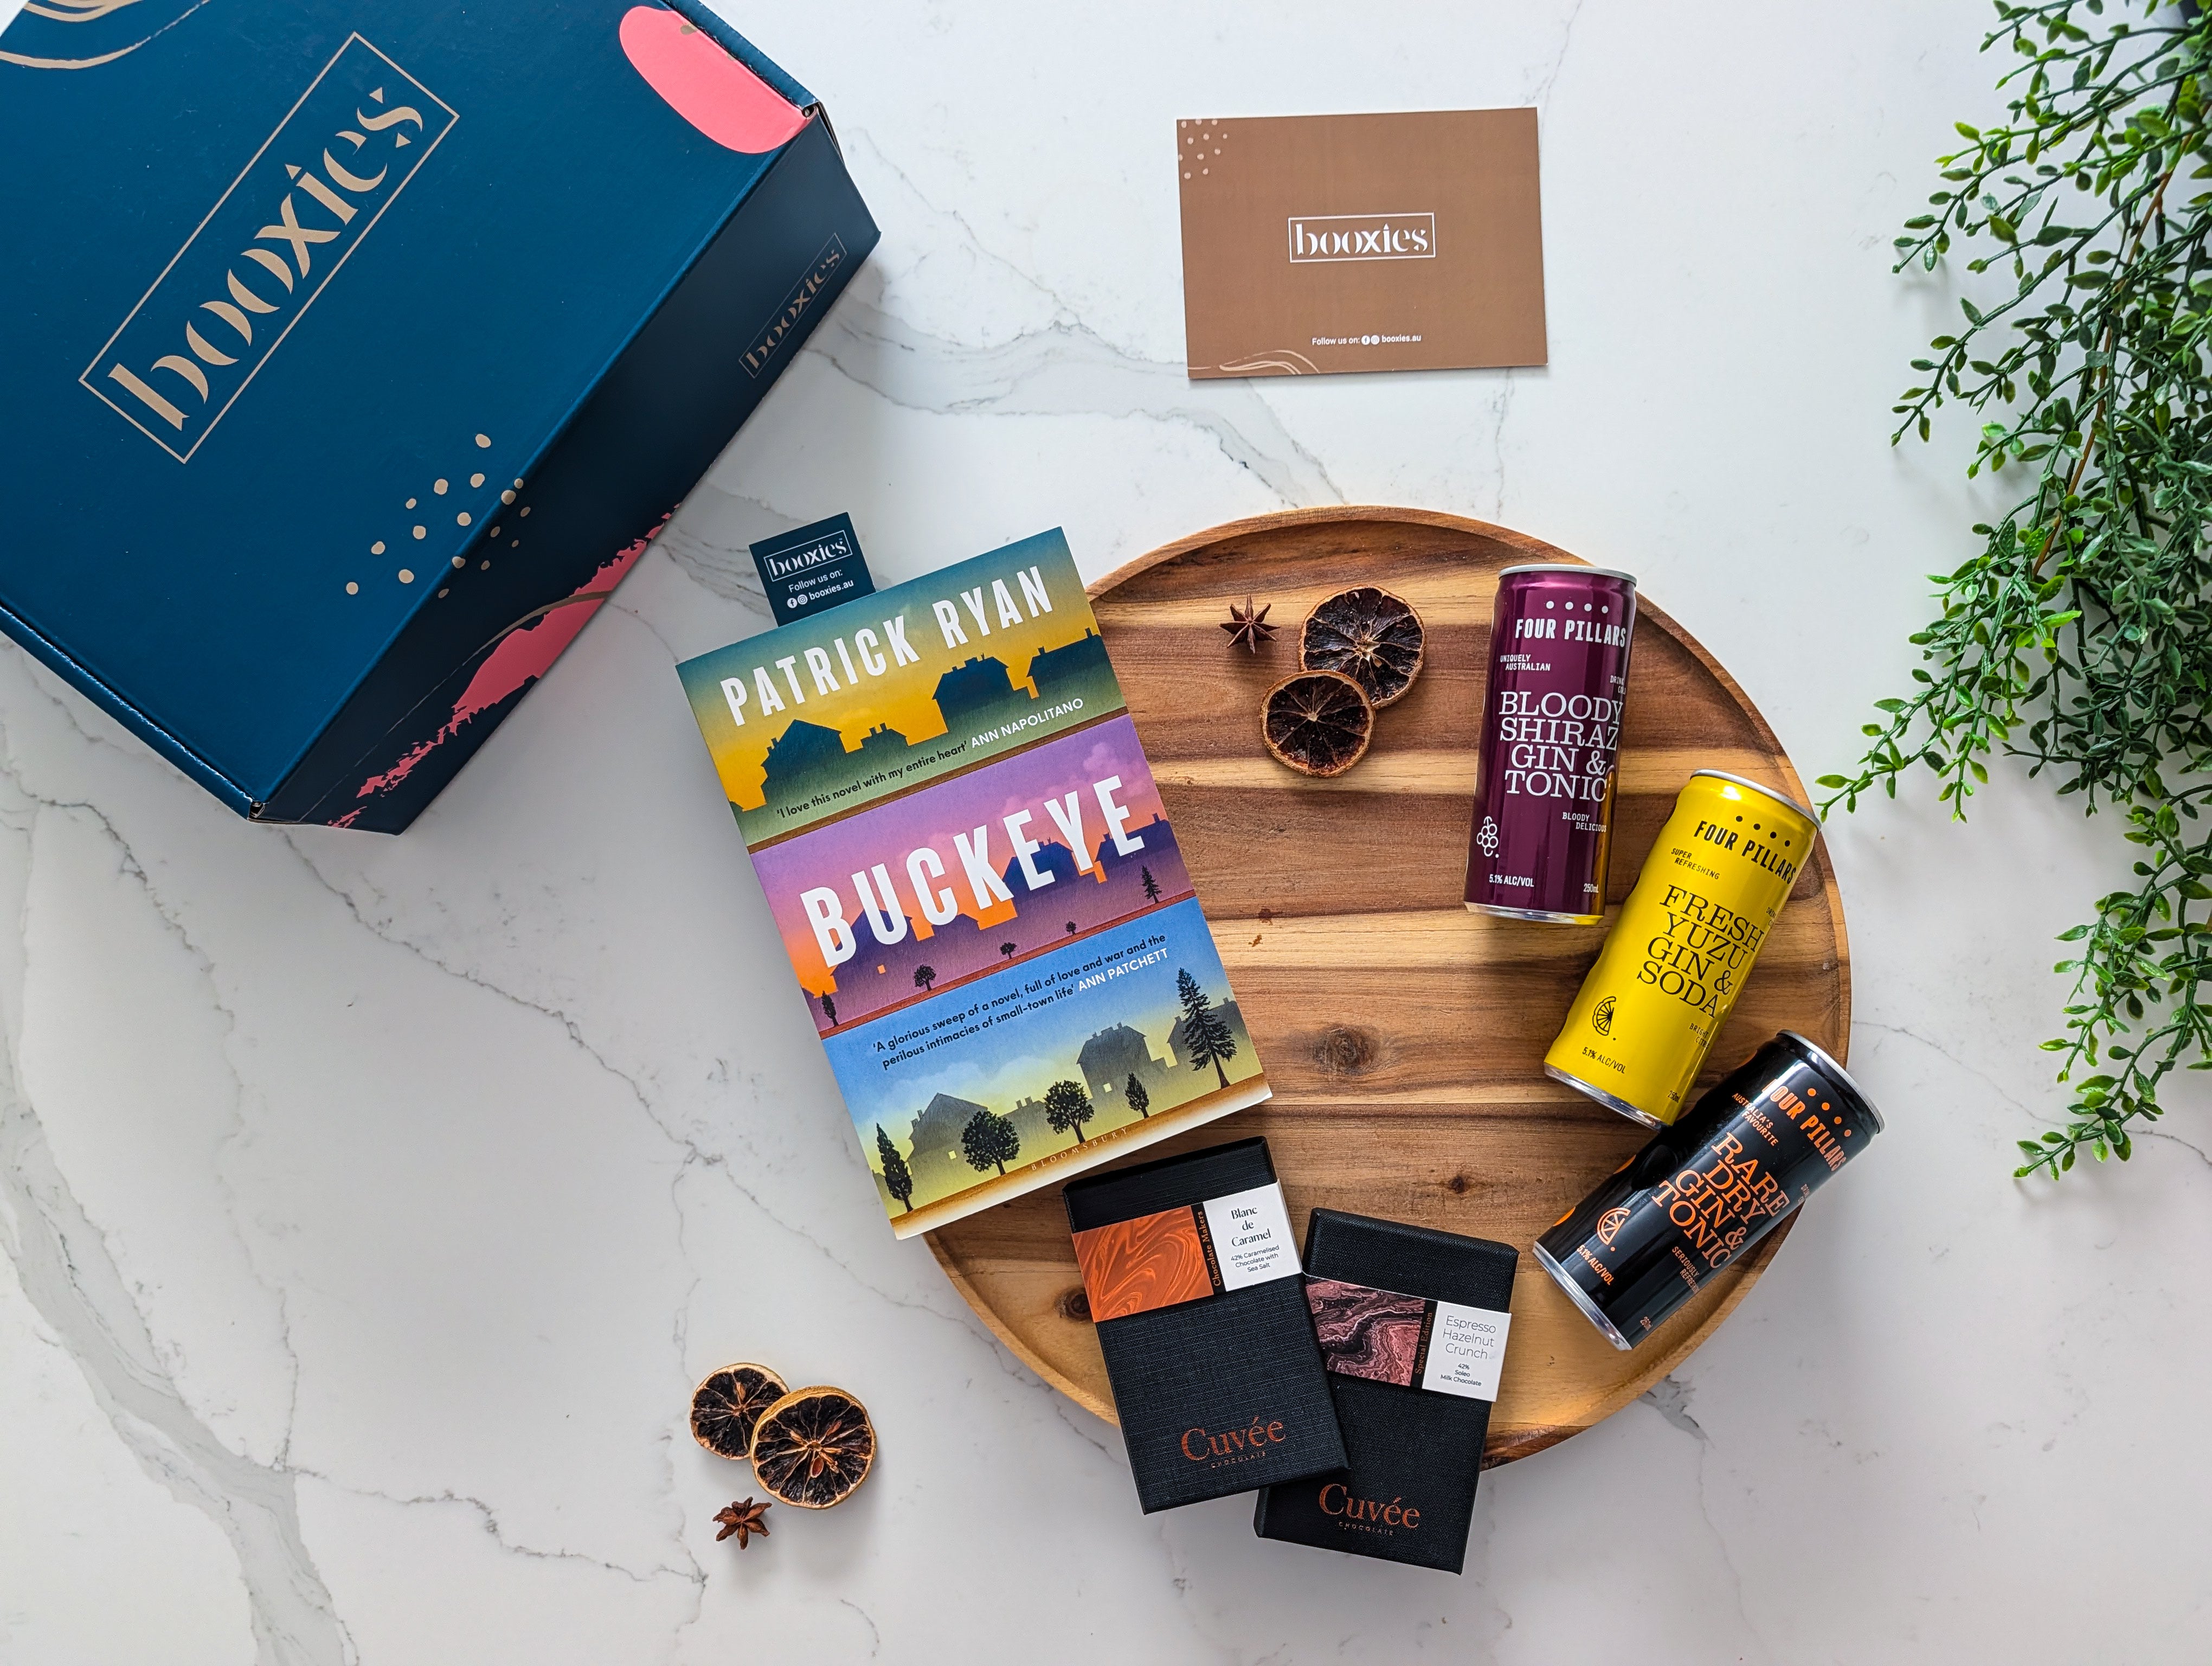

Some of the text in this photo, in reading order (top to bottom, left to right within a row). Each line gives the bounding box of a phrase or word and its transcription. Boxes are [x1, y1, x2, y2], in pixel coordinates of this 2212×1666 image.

[1296, 223, 1428, 255] booxies
[108, 87, 423, 431] booxies
[746, 248, 839, 369] booxies
[1312, 337, 1336, 345] Follow
[1381, 335, 1422, 343] booxies.au
[769, 541, 847, 576] booxies
[788, 569, 843, 593] Follow us on:
[808, 580, 854, 600] booxies.au
[721, 565, 1053, 727] PATRICK RYAN
[1515, 619, 1626, 648] FOUR PILLARS
[1500, 654, 1531, 662] UNIQUELY
[1505, 663, 1551, 671] AUSTRALIAN
[1499, 691, 1623, 725] BLOODY
[1500, 717, 1619, 751] SHIRAZ
[786, 802, 810, 816] love
[812, 793, 831, 806] this
[832, 780, 861, 799] novel
[863, 772, 886, 787] with
[888, 767, 903, 778] my
[906, 756, 936, 772] entire
[937, 740, 967, 760] heart'
[972, 729, 999, 748] ANN
[1000, 698, 1083, 736] NAPOLITANO
[1511, 744, 1606, 776] GIN &
[1504, 770, 1607, 802] TONIC
[1562, 812, 1590, 822] BLOODY
[1576, 822, 1606, 832] DELICIOUS
[1671, 848, 1692, 860] SUPER
[1674, 858, 1720, 880] REFRESHING
[1694, 821, 1797, 885] FOUR PILLARS
[800, 774, 1146, 968] BUCKEYE
[1489, 874, 1534, 887] 5.1% ALC/VOL
[1659, 884, 1765, 952] FRESH
[1663, 912, 1748, 970] YUZU
[1648, 937, 1733, 995] GIN &
[888, 1026, 930, 1050] glorious
[932, 1013, 966, 1030] sweep
[968, 1003, 979, 1016] of
[991, 988, 1024, 1008] novel,
[1025, 979, 1042, 994] full
[1044, 973, 1056, 986] of
[1057, 968, 1081, 982] love
[1082, 956, 1103, 972] and
[1104, 951, 1124, 963] war
[1127, 939, 1147, 954] and
[1148, 934, 1166, 946] the
[1637, 960, 1719, 1018] SODA
[882, 948, 1168, 1071] perilous intimacies of small-town life' ANN PATCHETT
[1689, 1023, 1709, 1038] BRIGHT
[1582, 1047, 1626, 1074] 5.1% ALC/VOL
[1732, 1093, 1773, 1129] AUSTRALIA'S
[1742, 1111, 1778, 1146] FAVOURITE
[1800, 1115, 1847, 1171] PILLARS
[1031, 1127, 1128, 1171] BLOOMSBURY
[1712, 1132, 1790, 1217] RARE
[1702, 1159, 1766, 1224] DRY
[1231, 1207, 1258, 1219] Blanc
[1242, 1220, 1255, 1231] de
[1651, 1181, 1732, 1268] TONIC
[1676, 1169, 1747, 1249] GIN &
[1198, 1211, 1221, 1286] Chocolate Makers
[1232, 1228, 1271, 1247] Caramel
[1244, 1245, 1279, 1259] Caramelised
[1235, 1257, 1264, 1267] Chocolate
[1577, 1245, 1614, 1285] 5.1% ALC/VOL
[1672, 1246, 1700, 1277] SERIOUSLY
[1443, 1328, 1495, 1347] Hazelnut
[1446, 1315, 1496, 1334] Espresso
[1415, 1312, 1433, 1374] Special Edition
[1445, 1343, 1488, 1360] Crunch
[1453, 1376, 1482, 1386] Chocolate
[1181, 1416, 1285, 1461] Cuvée
[1211, 1451, 1266, 1468] CHOCOLATE
[1319, 1483, 1420, 1529] Cuvée
[1339, 1522, 1393, 1536] CHOCOLATE
